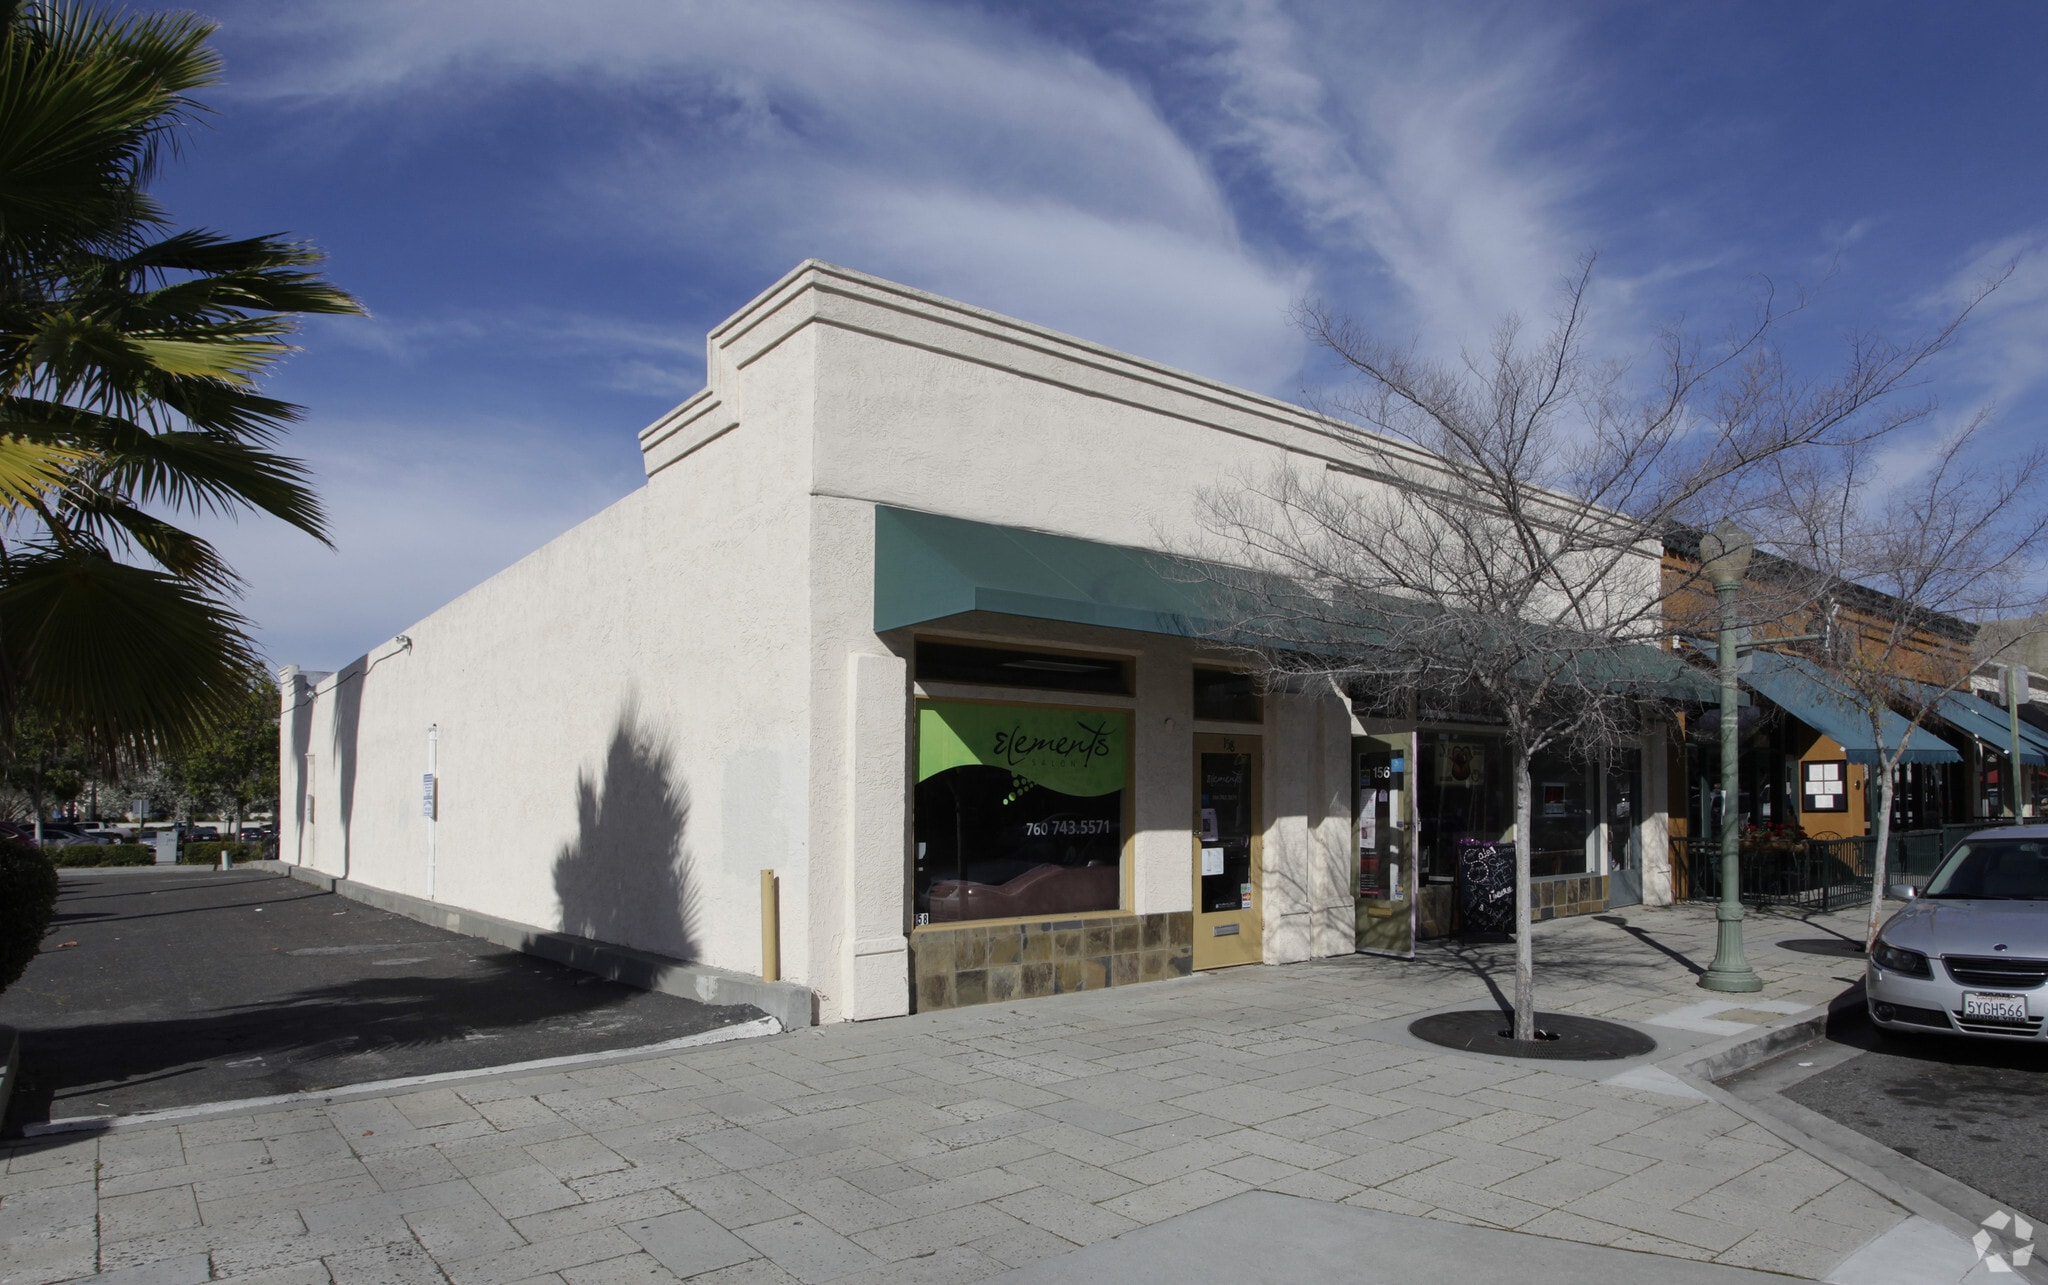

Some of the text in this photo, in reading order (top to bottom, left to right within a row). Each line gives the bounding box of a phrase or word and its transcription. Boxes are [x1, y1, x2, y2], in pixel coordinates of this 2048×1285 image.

[993, 720, 1118, 768] Elements
[1031, 759, 1076, 768] SALON
[1372, 766, 1391, 779] 156
[1026, 819, 1110, 836] 760 743.5571
[1967, 1001, 2023, 1017] 5YGH566
